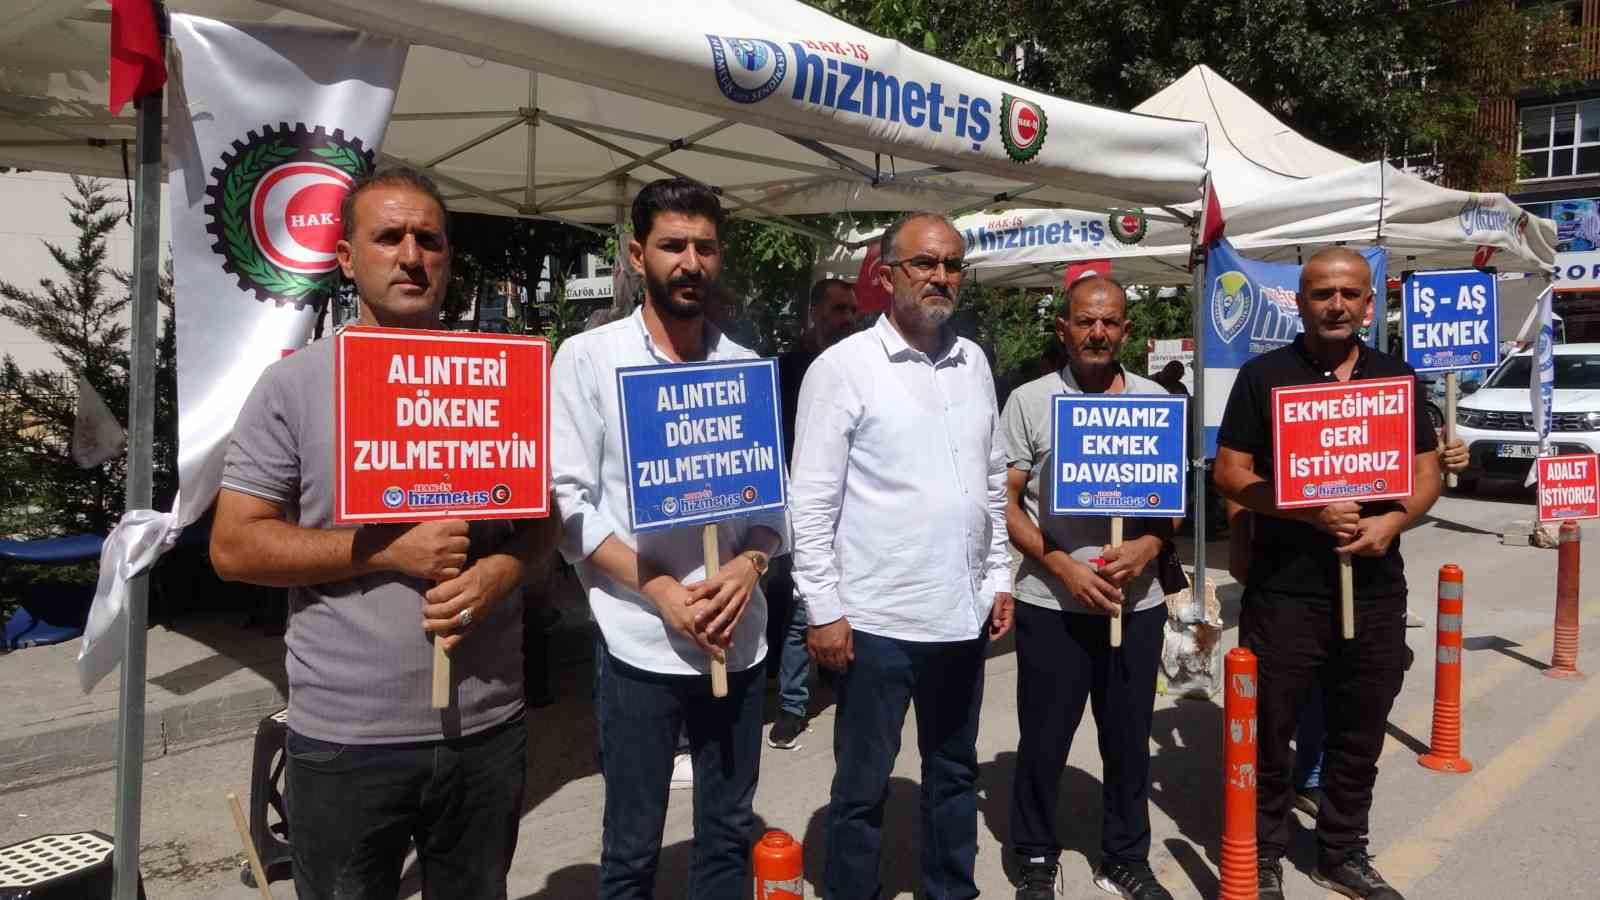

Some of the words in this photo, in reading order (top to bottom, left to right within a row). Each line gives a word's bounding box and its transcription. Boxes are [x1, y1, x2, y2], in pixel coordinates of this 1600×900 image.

[789, 42, 991, 150] hizmet-iş
[290, 212, 341, 228] HAK-
[978, 219, 1105, 251] hizmet-iş
[1412, 281, 1435, 318] İŞ
[1456, 284, 1487, 316] AŞ
[1412, 319, 1490, 349] EKMEK
[387, 350, 507, 387] ALINTERİ
[656, 372, 746, 412] ALINTERİ
[1283, 388, 1405, 423] EKMEĞİMİZİ
[396, 389, 500, 428] DÖKENE
[1072, 406, 1169, 427] DAVAMIZ
[665, 413, 744, 448] DÖKENE
[1082, 434, 1159, 455] EKMEK
[1320, 419, 1369, 448] GERİ
[353, 431, 537, 471] ZULMETMEYİN
[637, 441, 775, 488] ZULMETMEYİN
[1289, 450, 1400, 478] İSTİYORUZ
[1062, 462, 1179, 483] DAVASIDIR
[1547, 461, 1588, 480] ADALET
[1541, 483, 1596, 506] İSTİYORUZ
